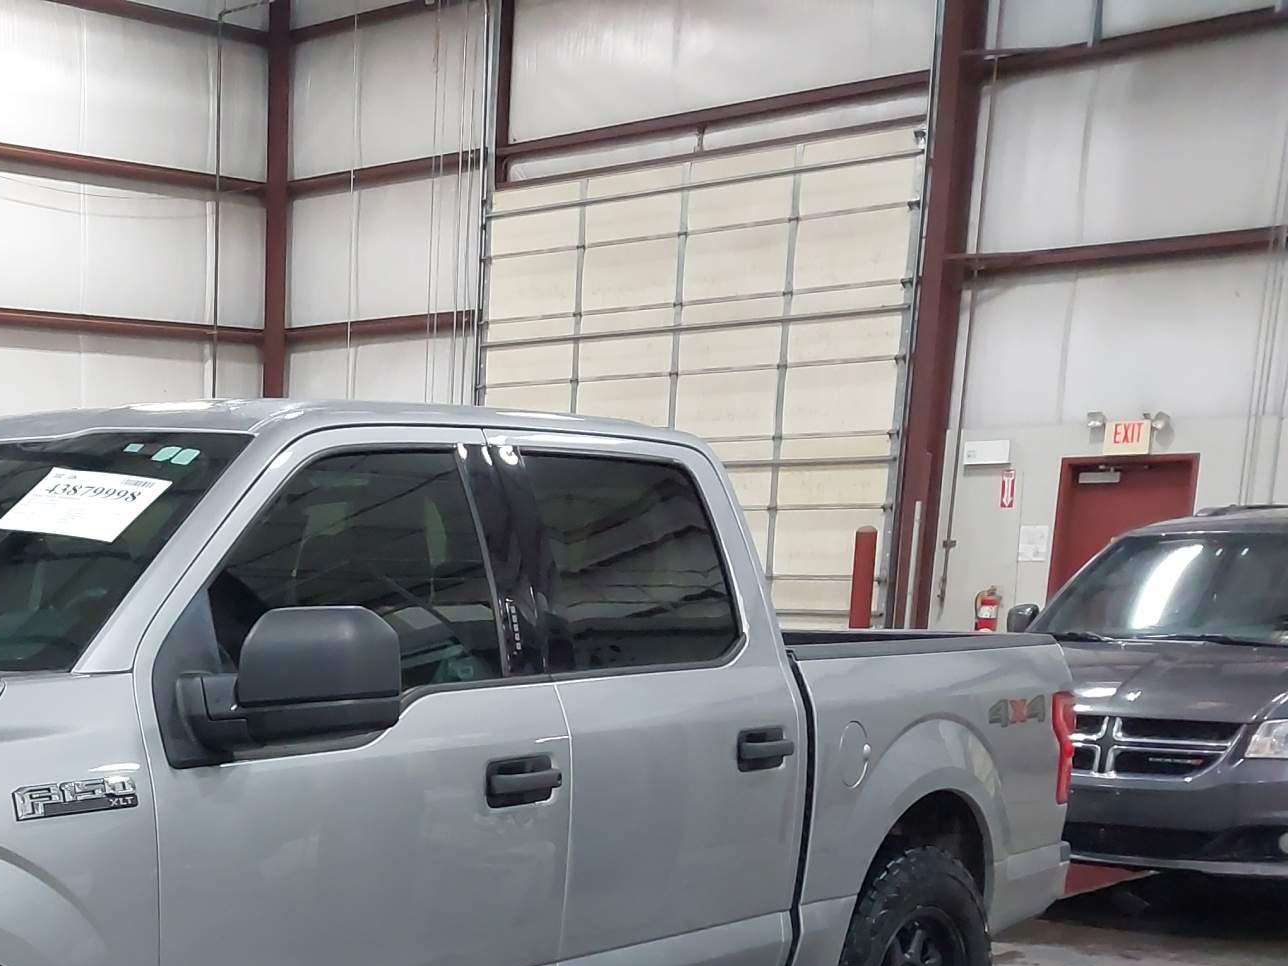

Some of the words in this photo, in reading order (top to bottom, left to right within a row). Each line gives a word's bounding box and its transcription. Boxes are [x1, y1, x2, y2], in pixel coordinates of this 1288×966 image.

[1113, 422, 1144, 444] EXIT
[45, 483, 142, 502] 43879998
[110, 796, 134, 807] XLT
